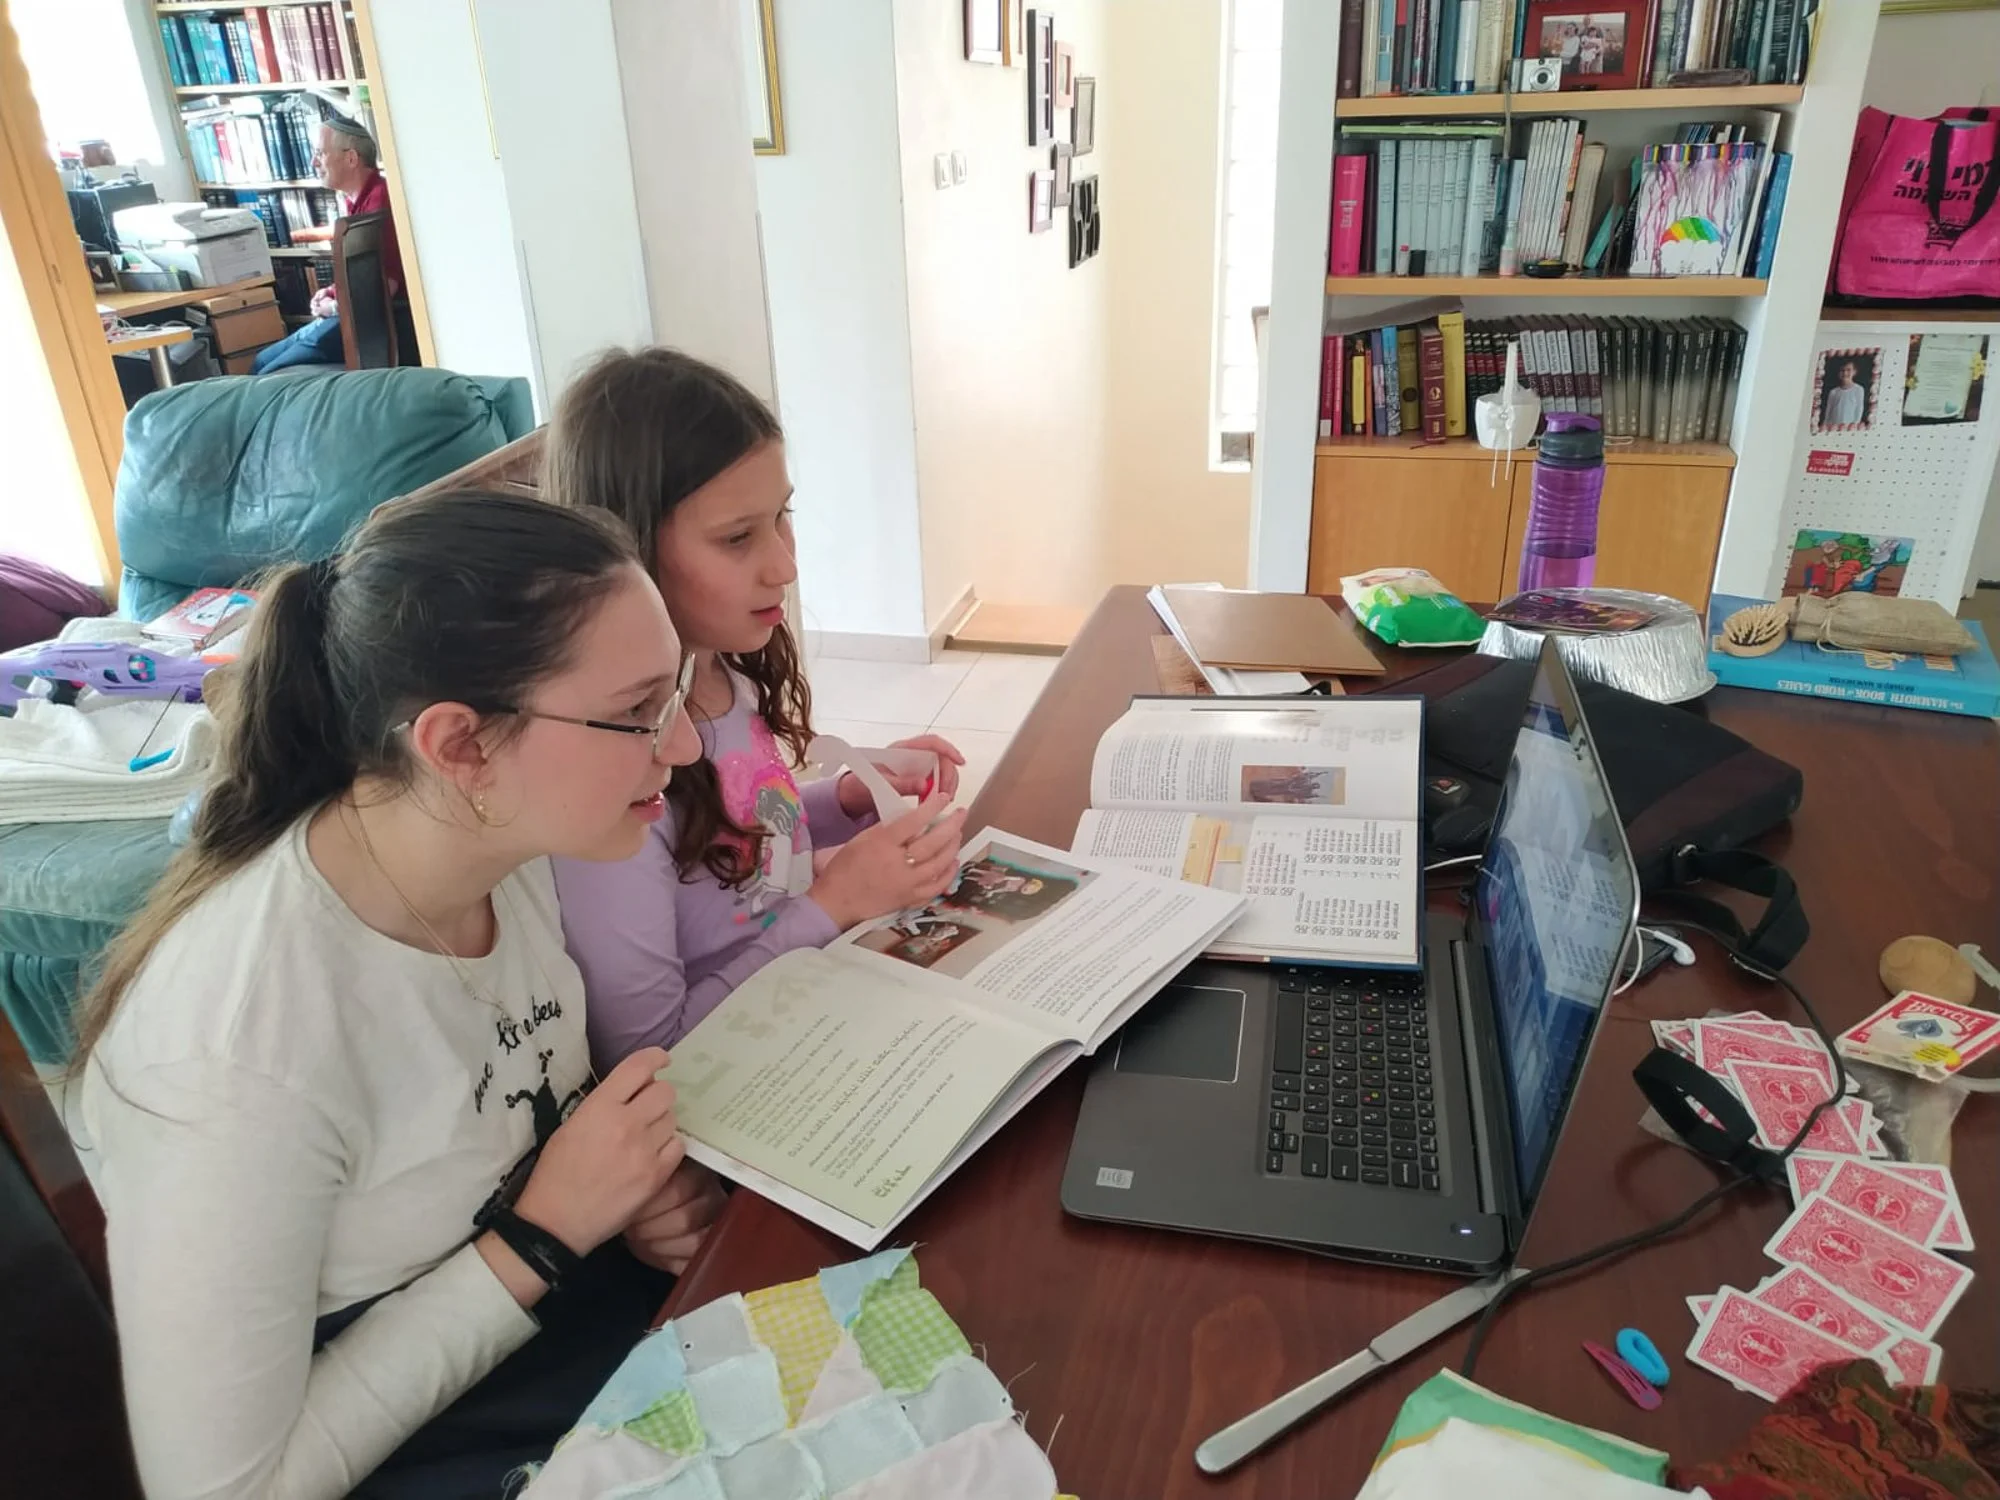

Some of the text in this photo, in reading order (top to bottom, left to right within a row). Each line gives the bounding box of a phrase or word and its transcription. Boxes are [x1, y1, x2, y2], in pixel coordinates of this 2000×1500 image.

[1777, 679, 1812, 693] GAMES
[1814, 684, 1847, 699] WORD
[1855, 688, 1886, 702] BOOK
[1891, 692, 1949, 711] MAMMOTH
[1904, 1000, 1983, 1030] BICYCLE
